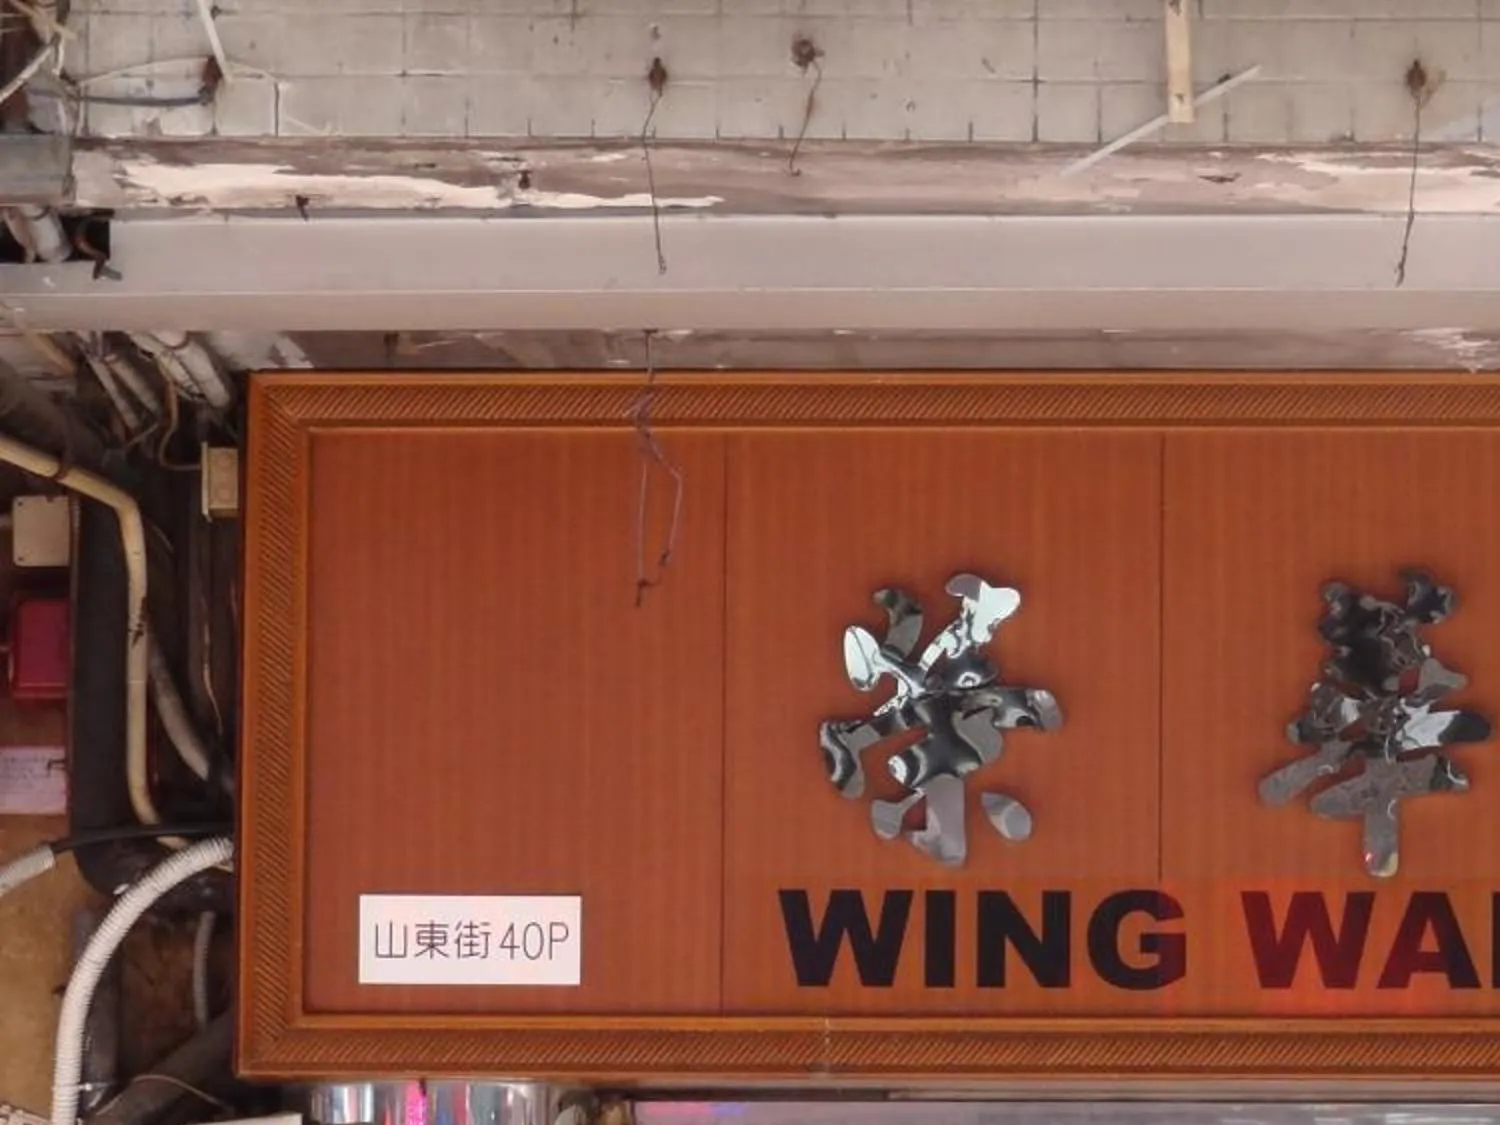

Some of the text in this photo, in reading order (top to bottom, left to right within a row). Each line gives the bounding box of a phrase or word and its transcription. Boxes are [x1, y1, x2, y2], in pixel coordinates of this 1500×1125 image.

[374, 919, 570, 961] 山東街40P
[778, 889, 1187, 991] WING
